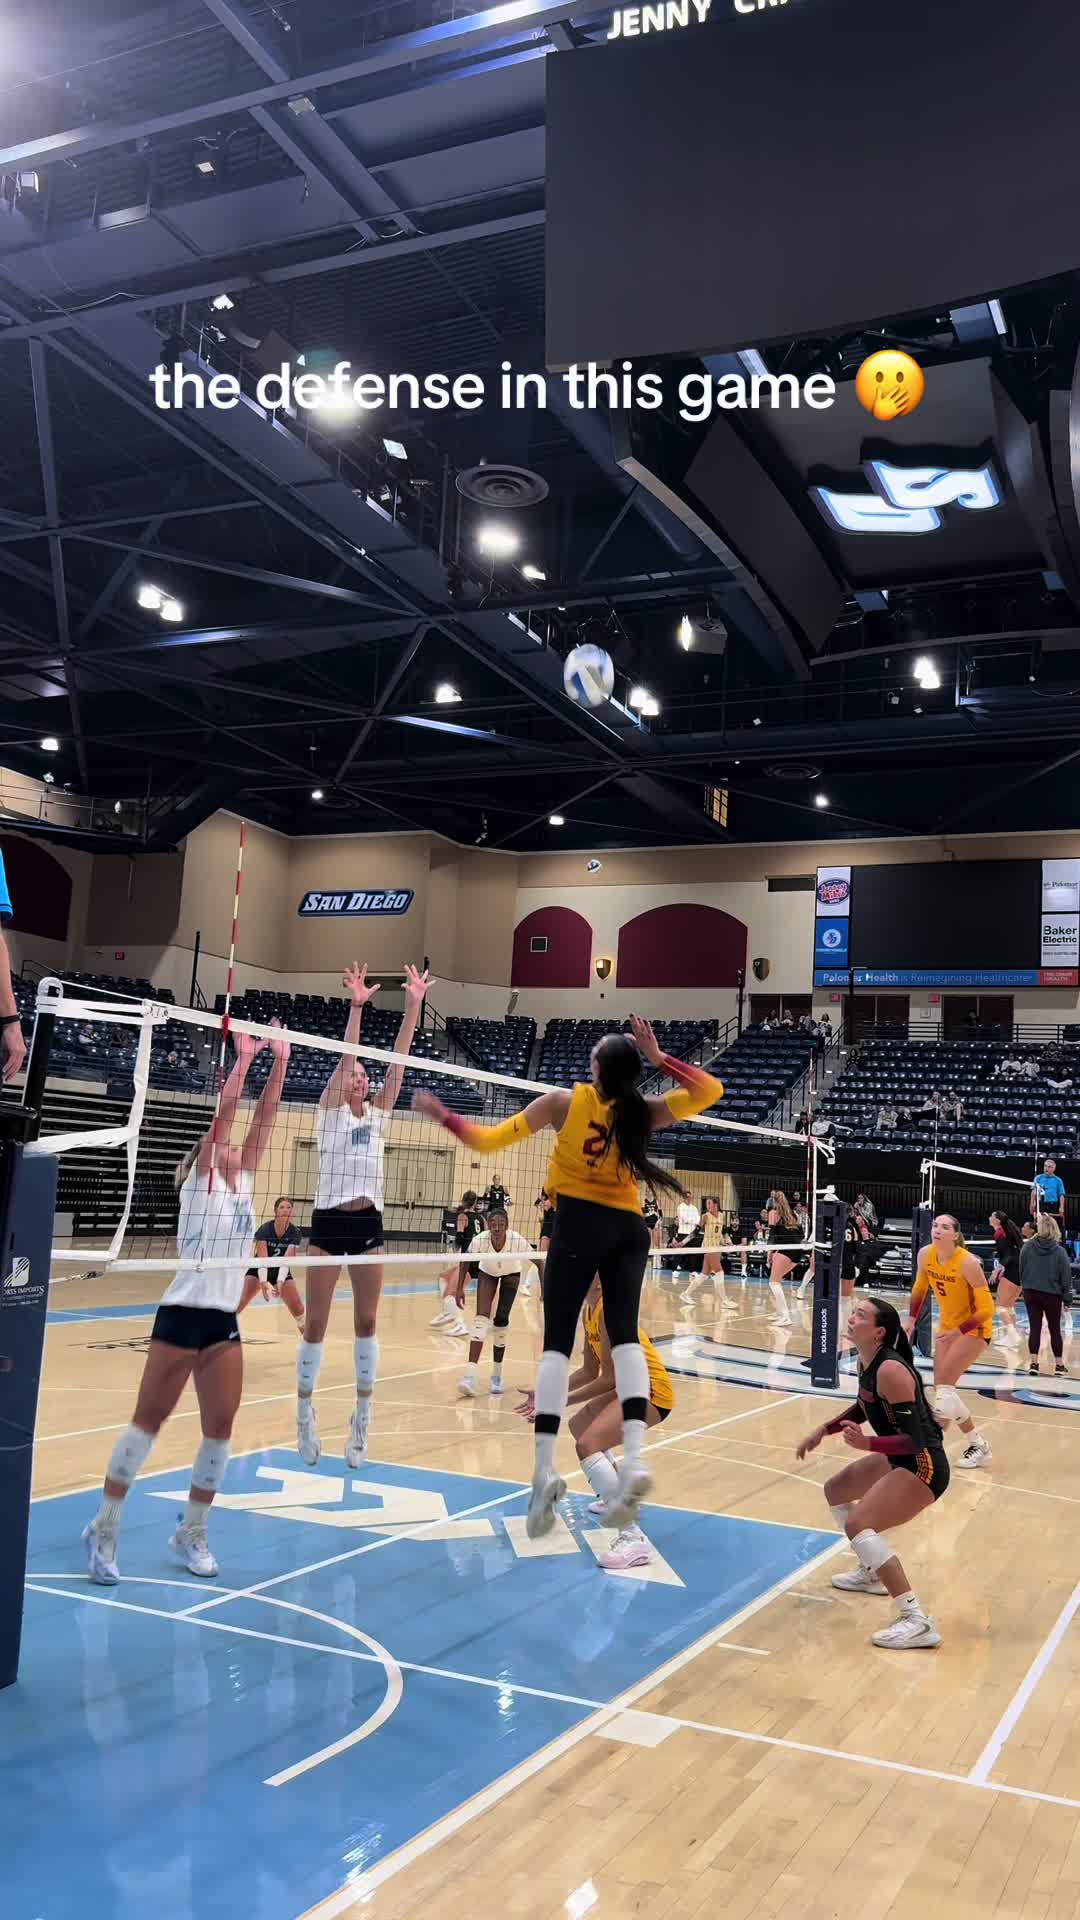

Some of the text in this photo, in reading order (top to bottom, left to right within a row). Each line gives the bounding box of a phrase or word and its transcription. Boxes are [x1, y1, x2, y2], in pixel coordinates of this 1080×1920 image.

[607, 0, 711, 40] JENNY
[302, 892, 409, 911] SAN DIEGO
[1043, 925, 1077, 936] Baker
[1042, 935, 1077, 944] Electric
[865, 971, 899, 982] Health
[582, 1119, 609, 1159] 2
[936, 1281, 947, 1297] 5
[820, 1308, 828, 1329] sports
